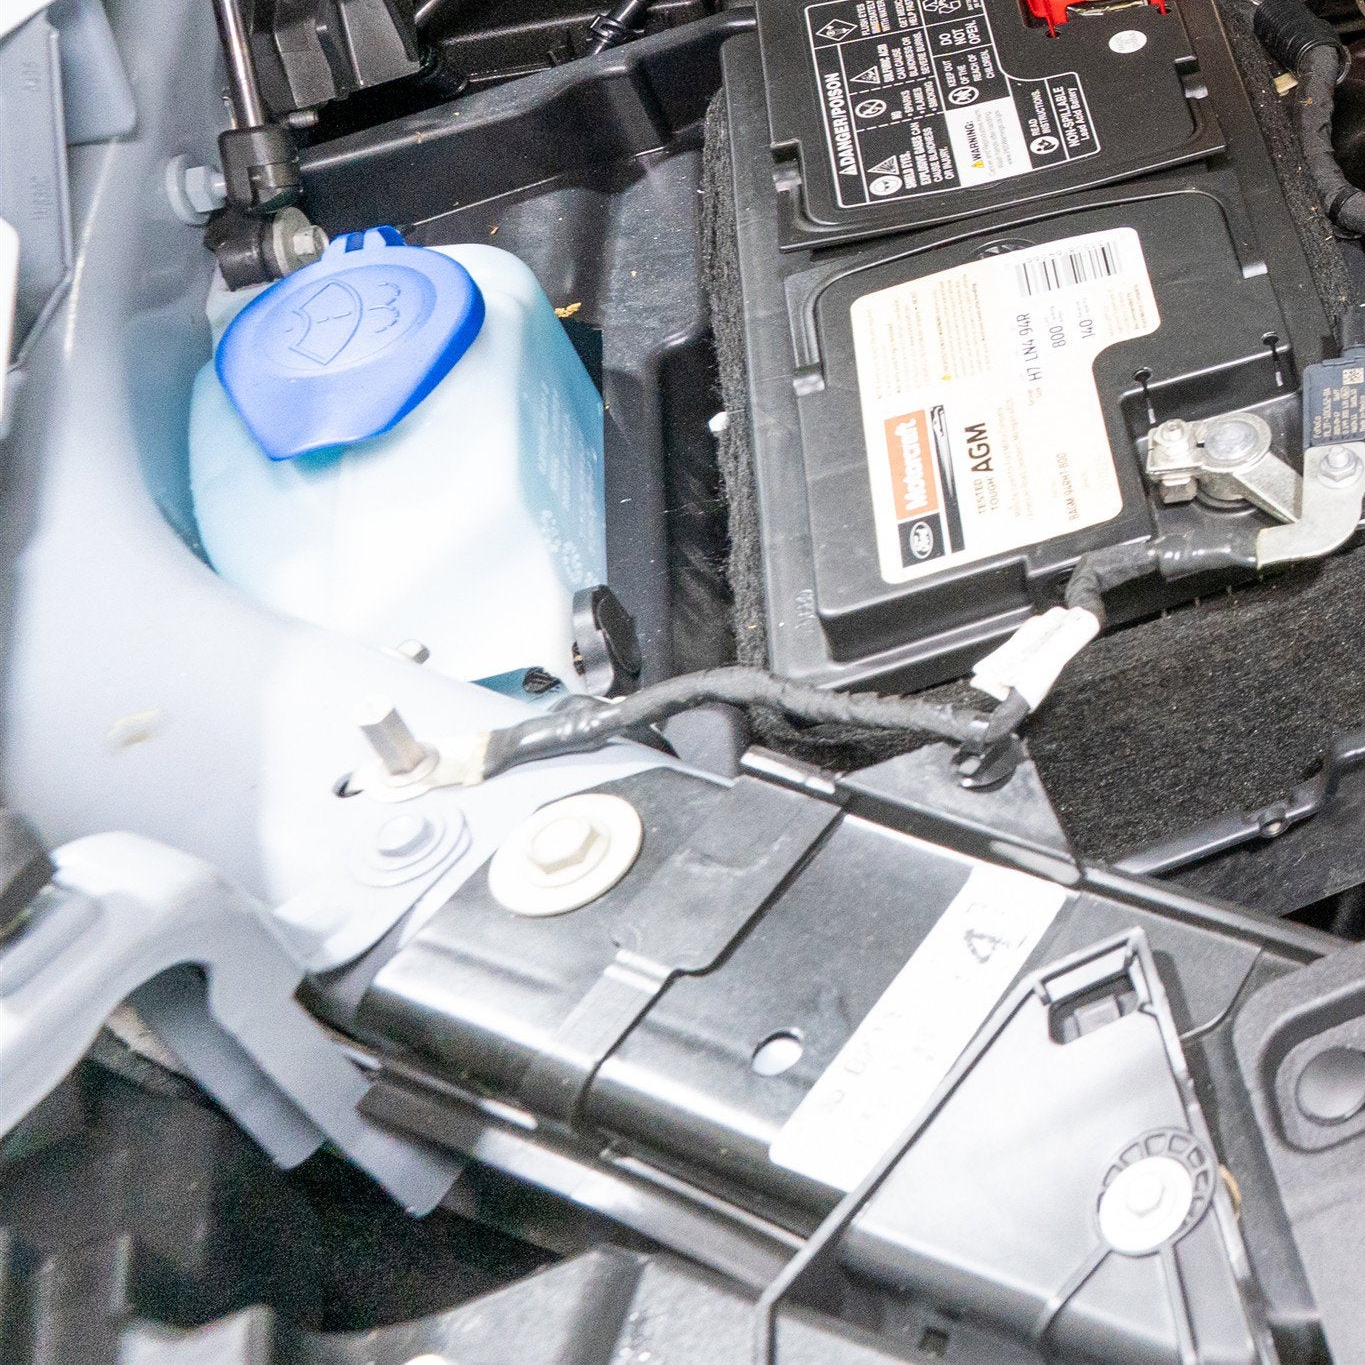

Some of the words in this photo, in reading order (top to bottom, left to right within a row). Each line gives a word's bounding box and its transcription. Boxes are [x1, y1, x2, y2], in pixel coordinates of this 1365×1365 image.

[856, 3, 866, 17] EYES
[866, 0, 880, 33] IMMEDIATELY
[908, 12, 918, 26] HELP
[859, 18, 870, 35] FLUSH
[879, 17, 890, 31] WITH
[898, 16, 907, 27] GET
[902, 36, 911, 45] OR
[913, 31, 925, 51] BURNS.
[938, 32, 952, 45] DO
[951, 27, 967, 45] NOT
[964, 19, 981, 44] OPEN.
[878, 43, 889, 57] ACID
[891, 47, 903, 67] CAUSE
[967, 53, 977, 62] OF
[880, 57, 894, 82] SULFURIC
[904, 46, 918, 77] BLINDNESS
[918, 52, 930, 74] SEVERE
[942, 59, 952, 71] OUT
[957, 64, 967, 76] THE
[980, 49, 995, 78] CHILDREN.
[895, 67, 906, 79] CAN
[945, 72, 956, 87] KEEP
[959, 75, 969, 84] OF
[970, 62, 982, 81] REACH
[1067, 86, 1080, 109] Battery
[824, 72, 855, 166] DANGER/POISON
[1030, 89, 1051, 133] INSTRUCTIONS.
[1052, 86, 1080, 147] NON-SPILLABLE
[1072, 109, 1084, 124] Acid
[910, 121, 920, 135] CAN
[1028, 118, 1040, 136] READ
[1076, 124, 1089, 140] Lead
[912, 135, 924, 154] GASES
[922, 126, 938, 161] BLINDNESS
[963, 120, 982, 161] WARNING:
[939, 146, 952, 169] INJURY.
[902, 169, 916, 188] SHIELD
[916, 154, 930, 185] EXPLOSIVE
[929, 161, 943, 182] CAUSE
[944, 170, 954, 179] OR
[1015, 312, 1033, 336] 94R
[1078, 318, 1096, 339] 140
[1048, 324, 1066, 348] 800
[1021, 338, 1038, 361] LN4
[1025, 365, 1042, 381] H7
[963, 421, 994, 475] AGM
[893, 417, 928, 510] Motorcraft
[973, 478, 986, 514] TESTED
